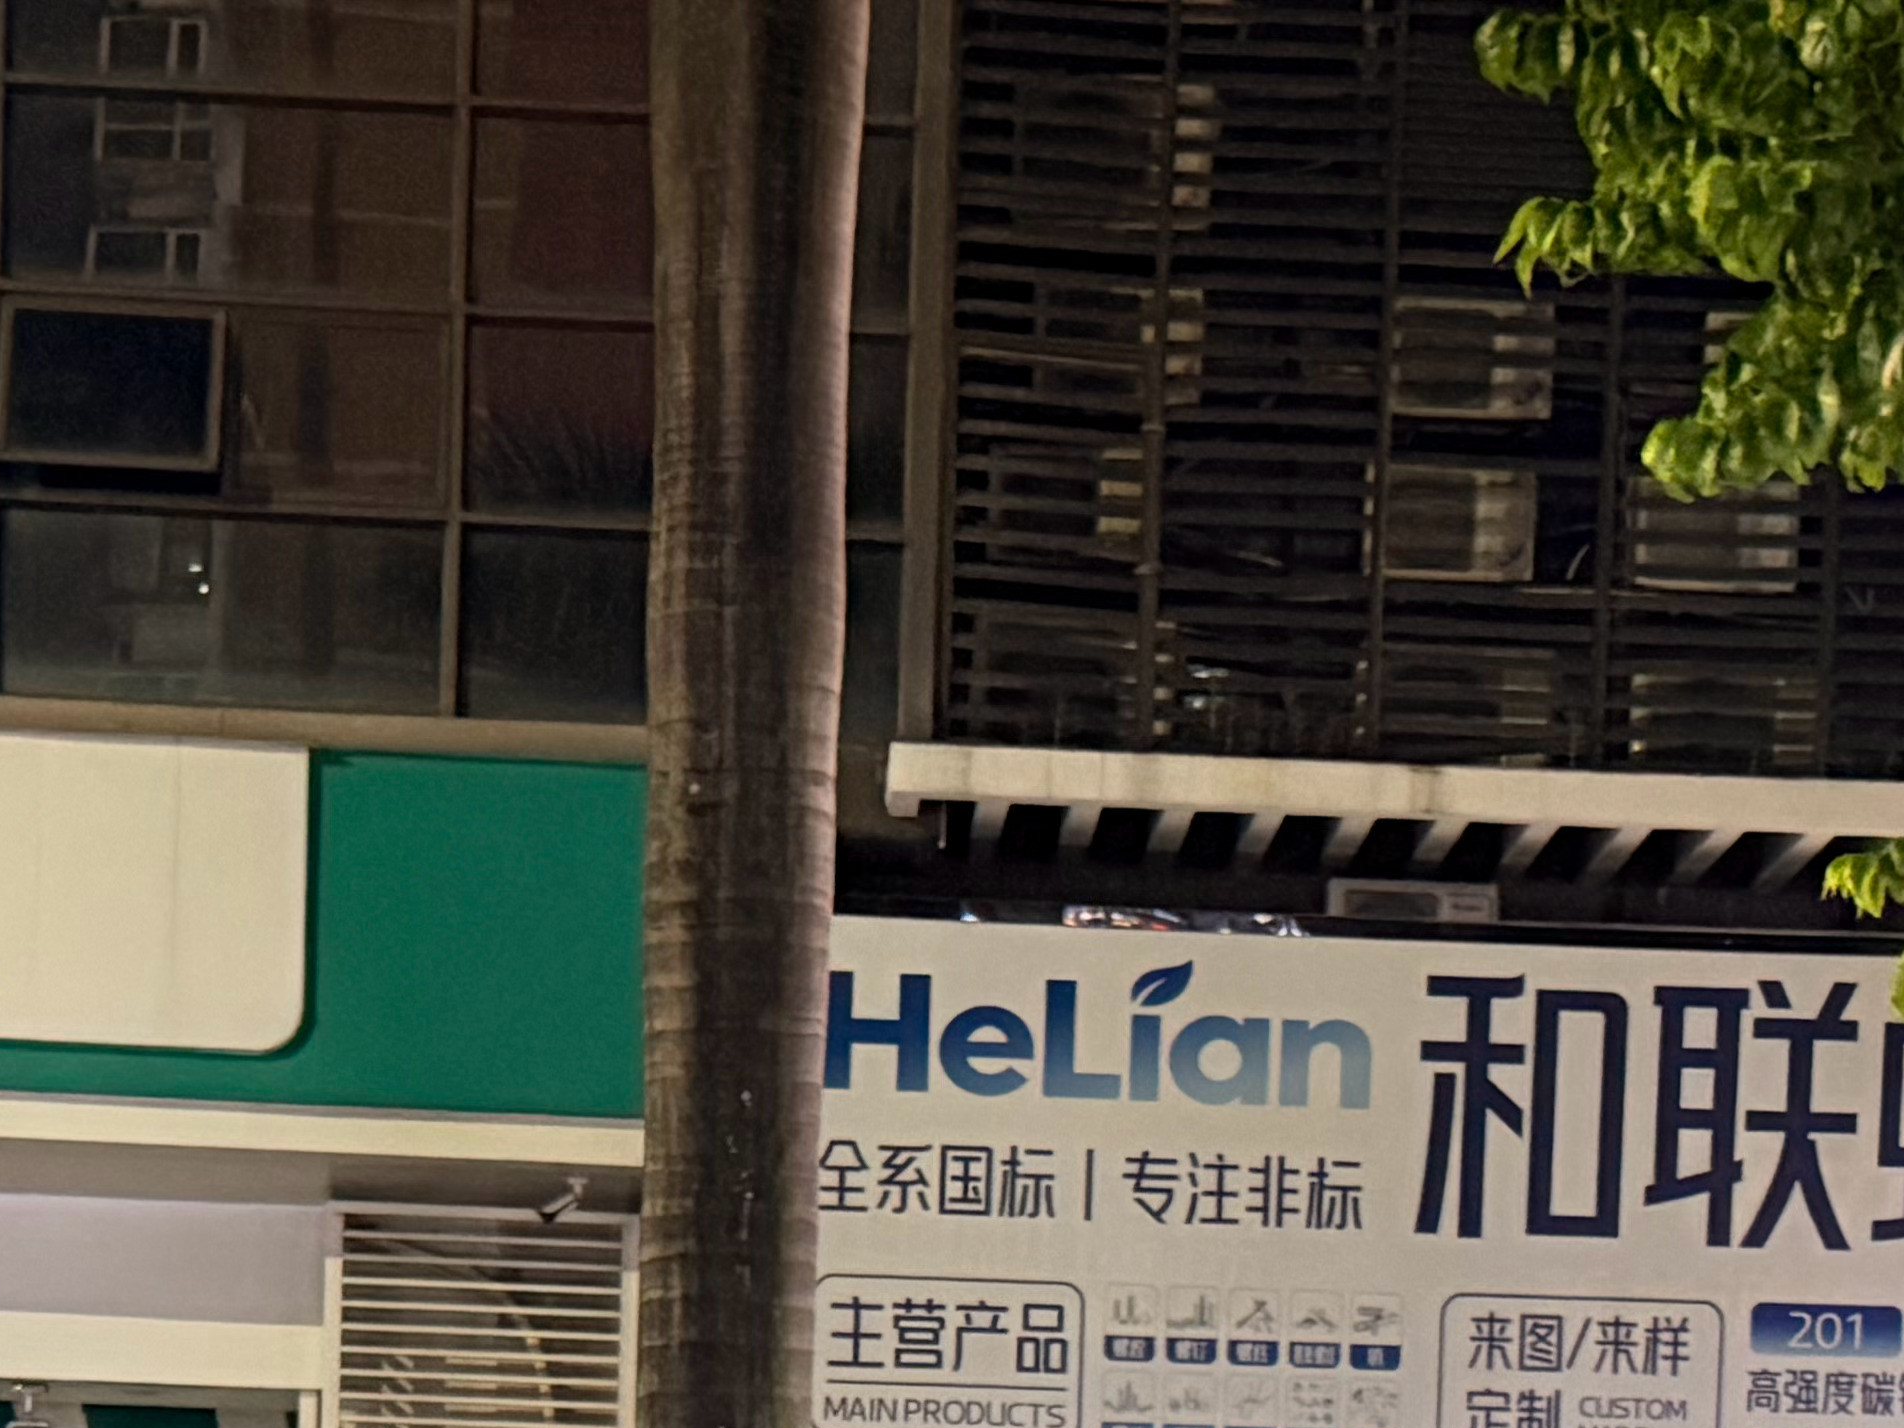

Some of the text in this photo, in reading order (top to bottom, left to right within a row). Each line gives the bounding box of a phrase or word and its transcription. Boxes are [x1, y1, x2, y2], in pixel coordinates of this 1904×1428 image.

[823, 960, 1373, 1110] HeLian
[818, 1140, 1364, 1231] 全系国标 专注非标
[827, 1296, 1069, 1375] 主营产品
[1467, 1311, 1691, 1378] 来图/来样
[1787, 1310, 1864, 1350] 201
[823, 1396, 1068, 1428] MAIN PRODUCTS
[1578, 1395, 1688, 1422] CUSTOM
